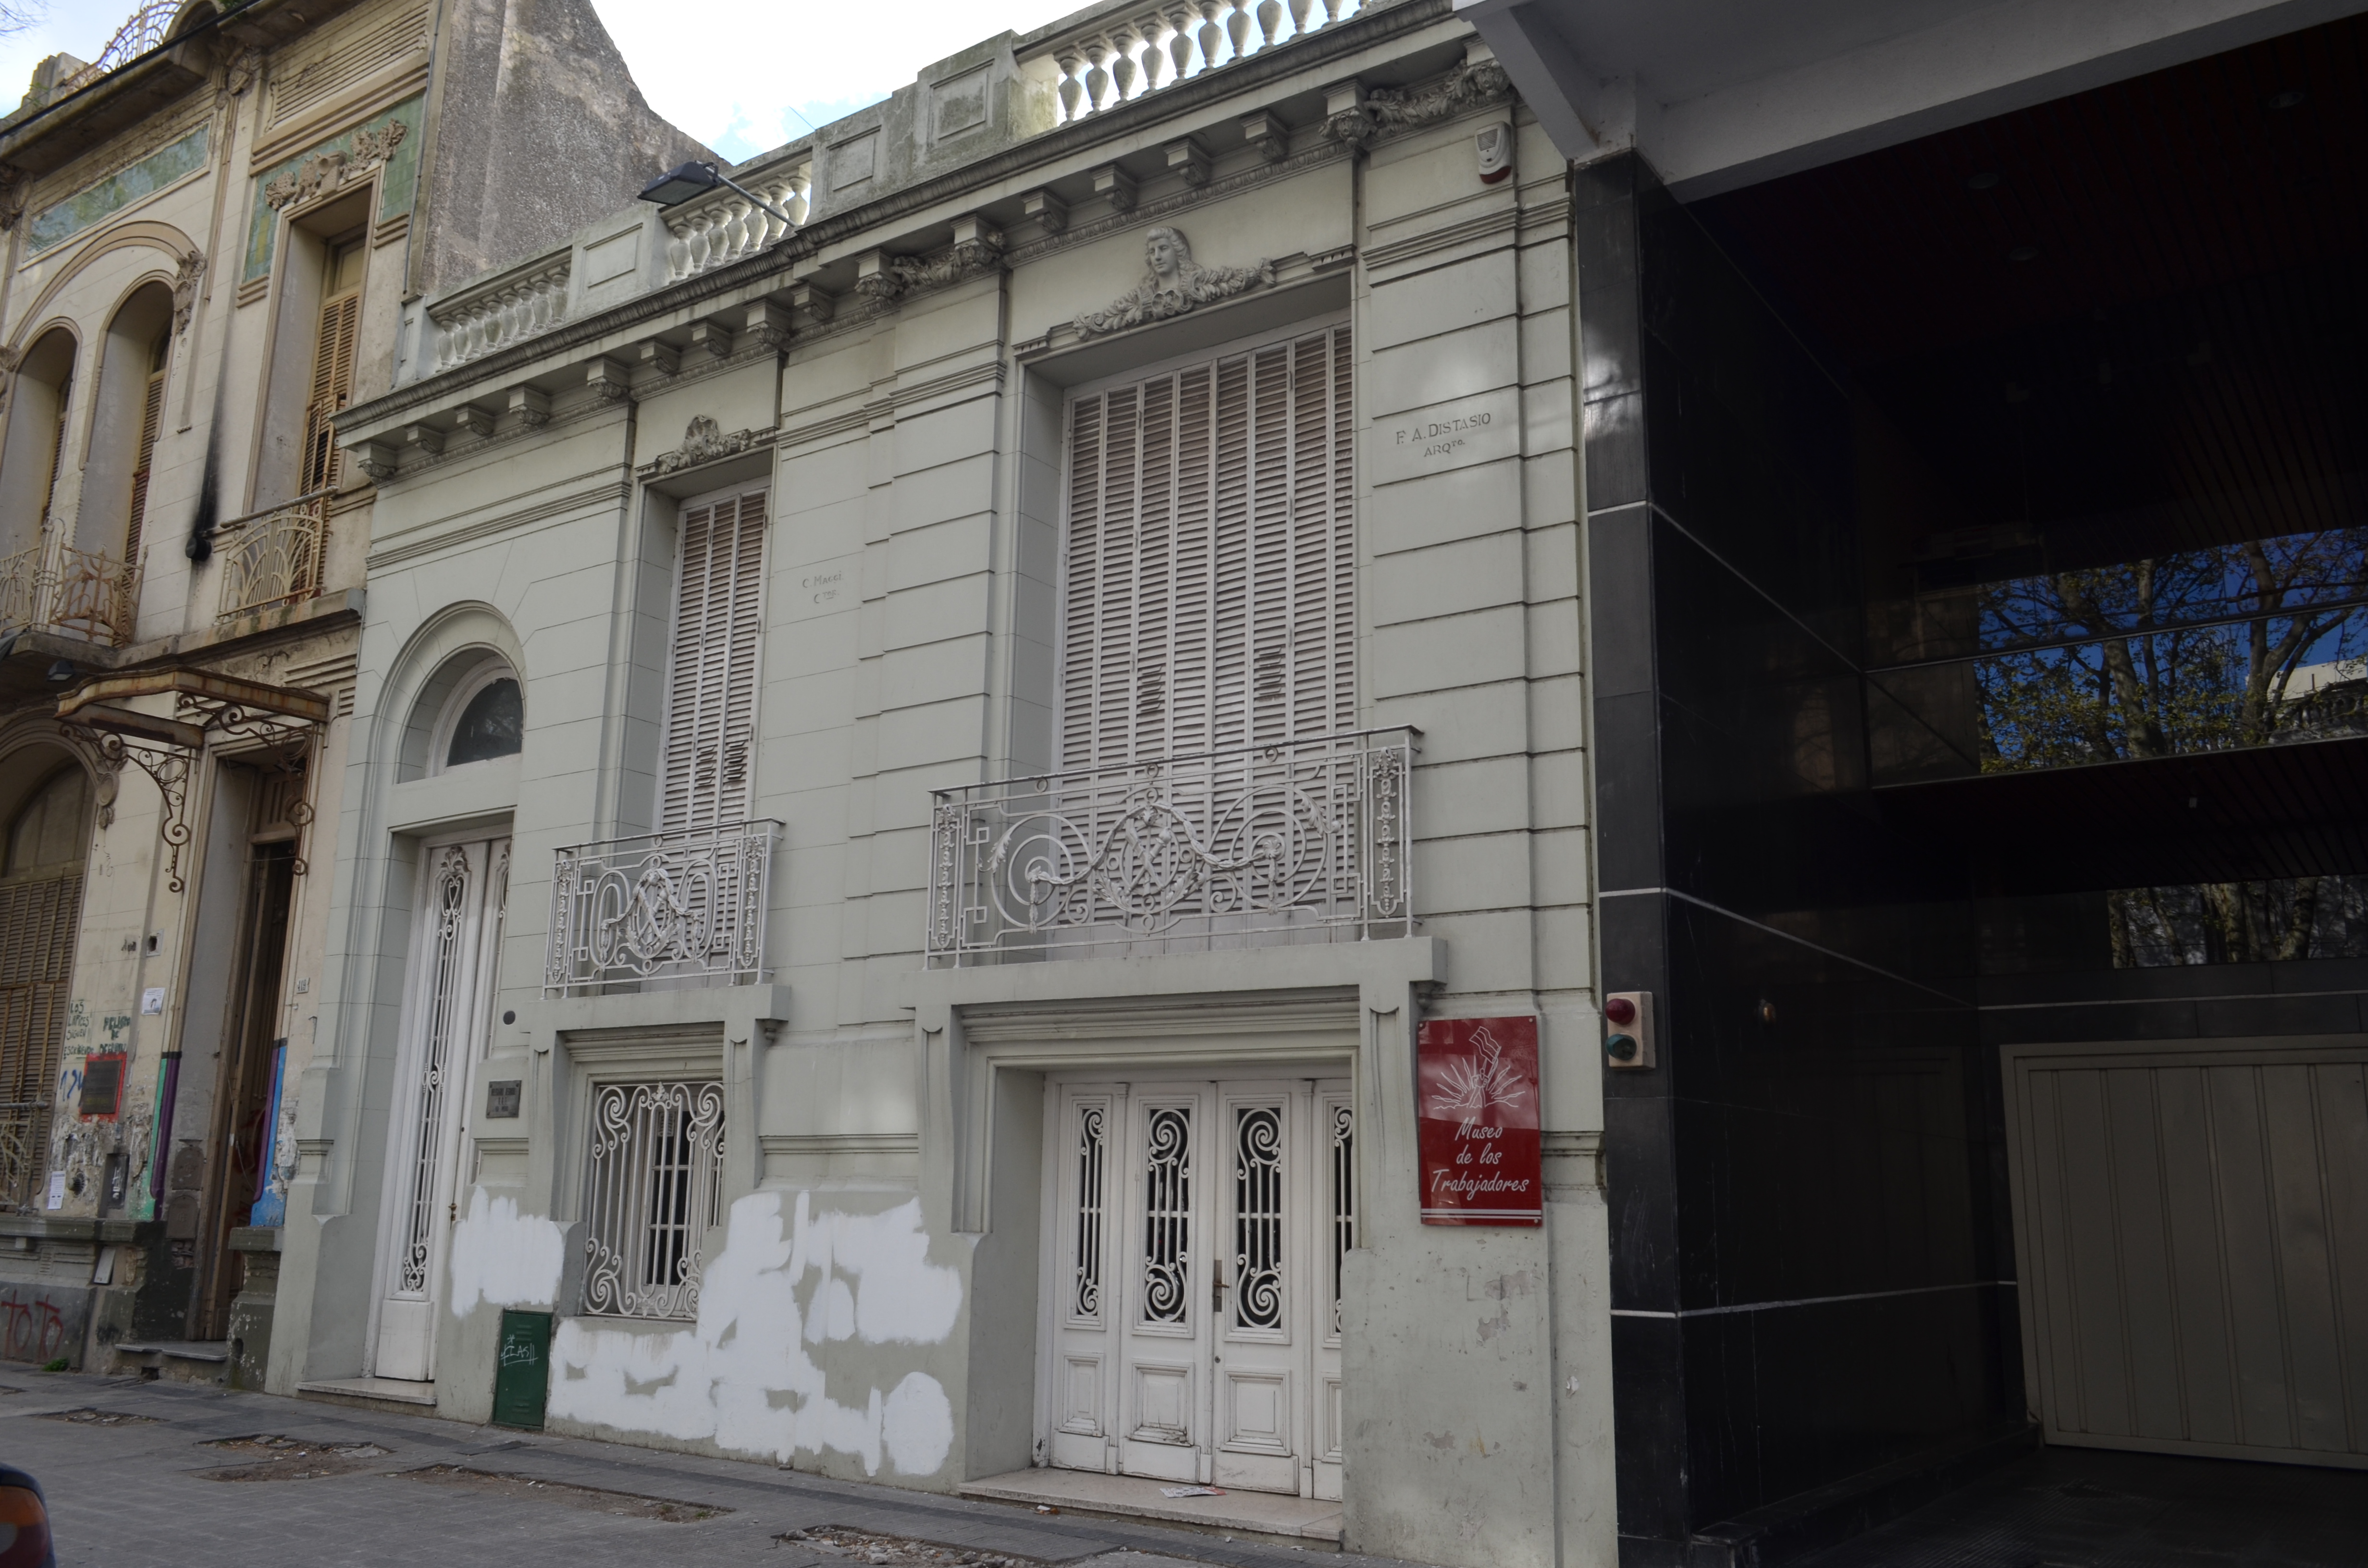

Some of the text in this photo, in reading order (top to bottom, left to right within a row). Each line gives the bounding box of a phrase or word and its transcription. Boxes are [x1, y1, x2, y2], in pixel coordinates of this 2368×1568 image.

[1396, 430, 1406, 444] F.
[1428, 413, 1491, 438] DISTASIO
[70, 1002, 84, 1014] LOS
[1455, 1116, 1503, 1141] Museo
[1456, 1142, 1502, 1165] de los
[1431, 1168, 1529, 1201] Trabajadores
